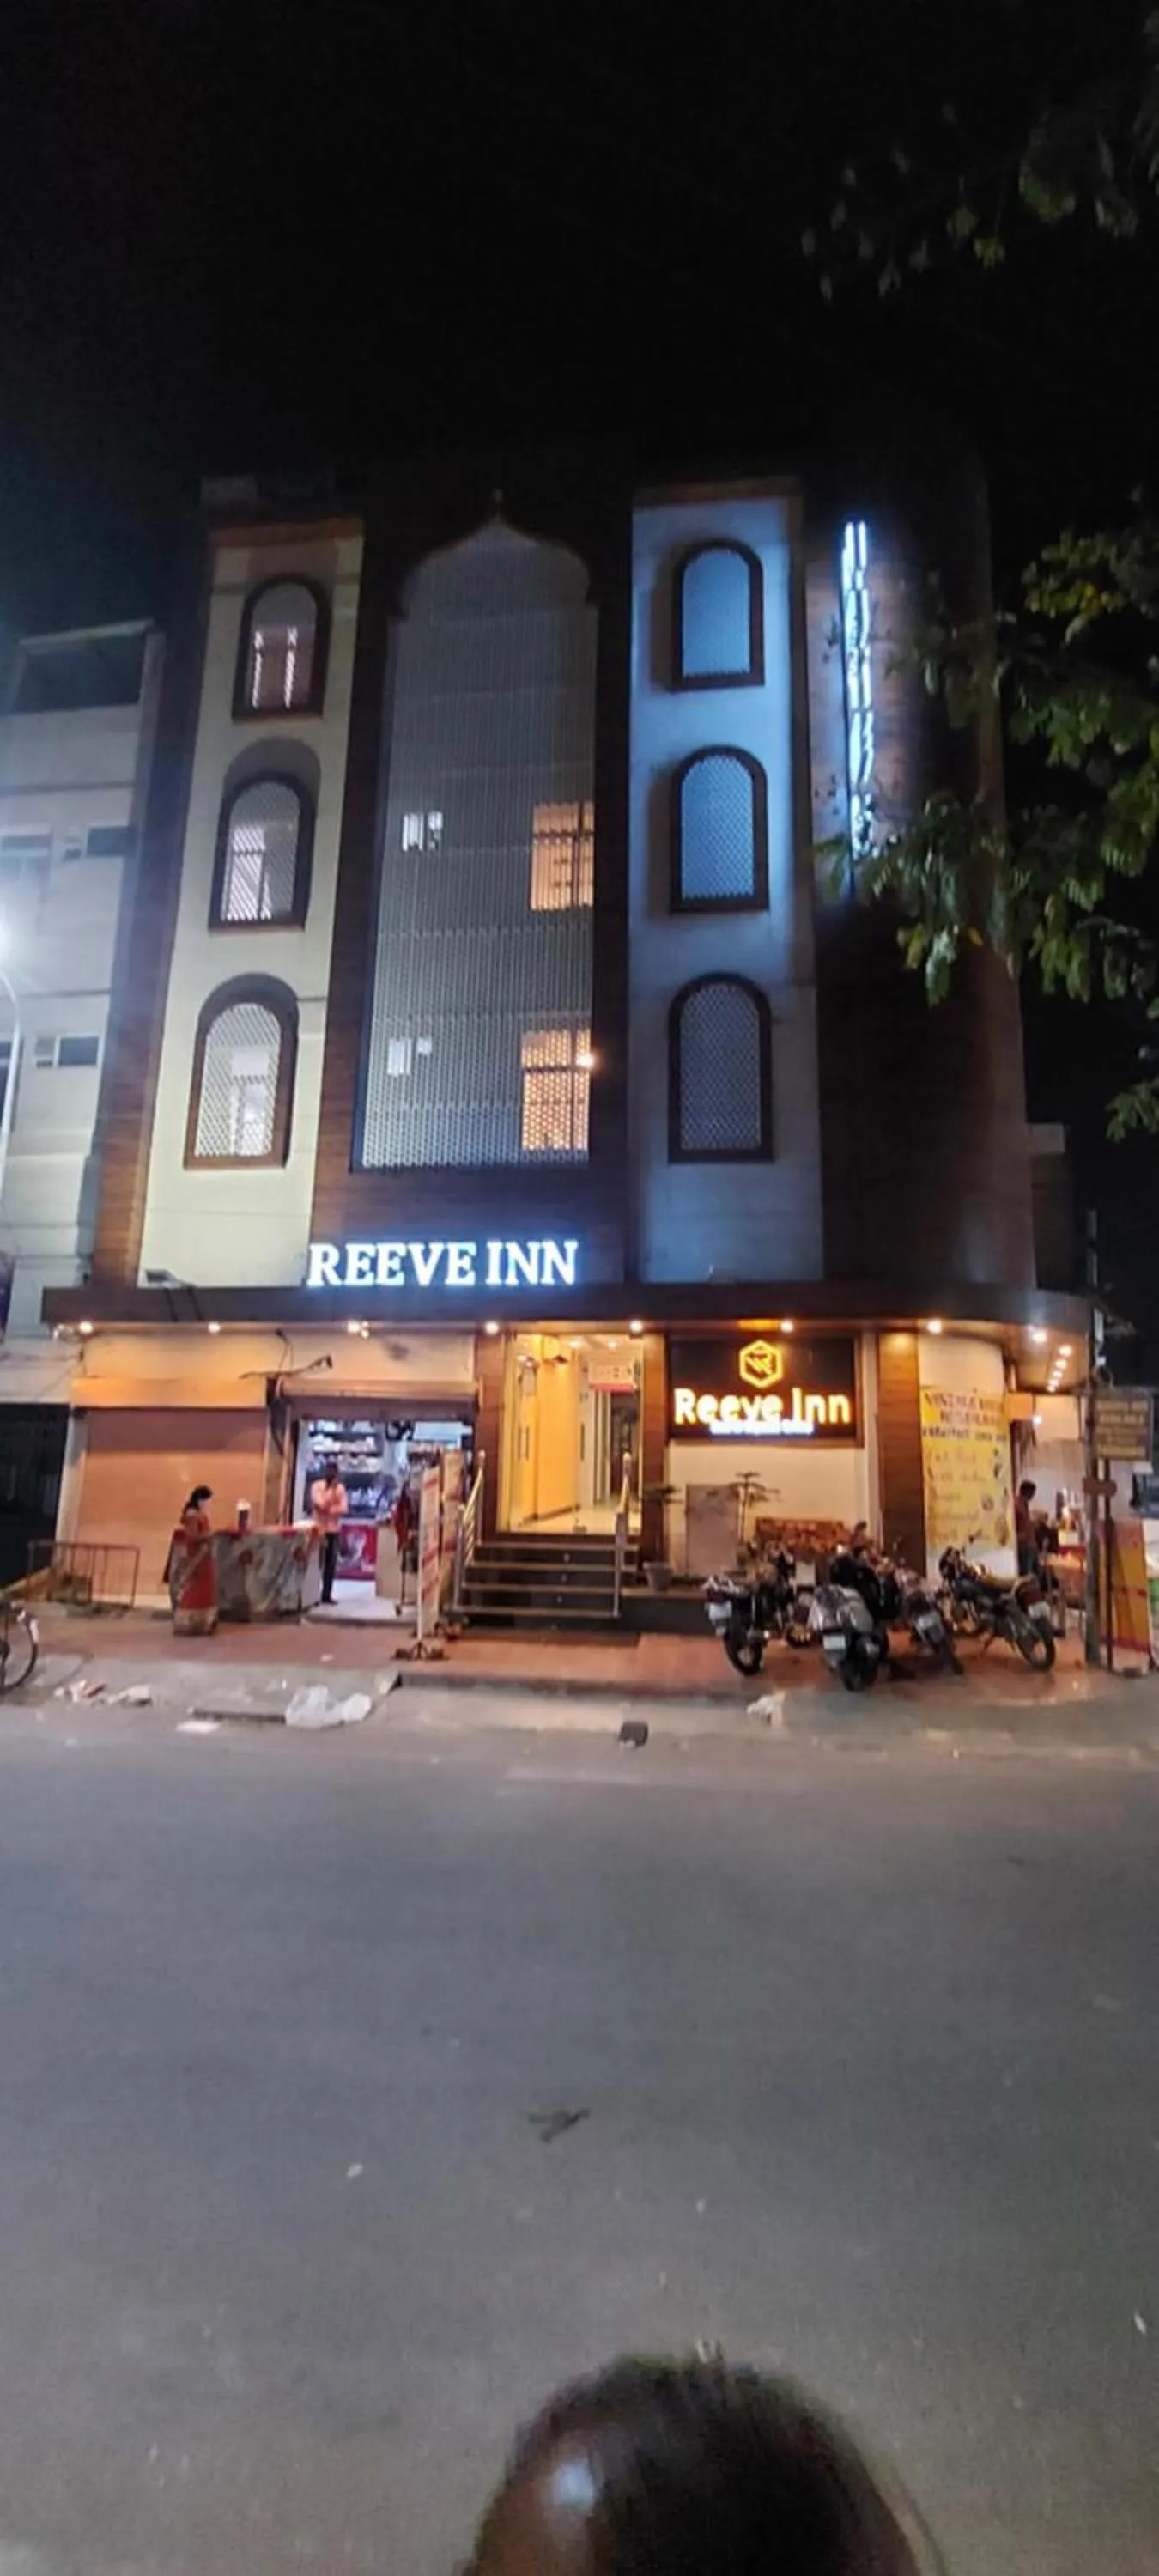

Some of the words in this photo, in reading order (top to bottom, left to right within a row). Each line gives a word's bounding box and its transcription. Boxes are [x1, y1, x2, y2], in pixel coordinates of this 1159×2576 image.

[306, 1242, 477, 1287] REEVE
[485, 1239, 579, 1286] INN
[673, 1388, 783, 1425] Reeve
[791, 1387, 851, 1425] Inn
